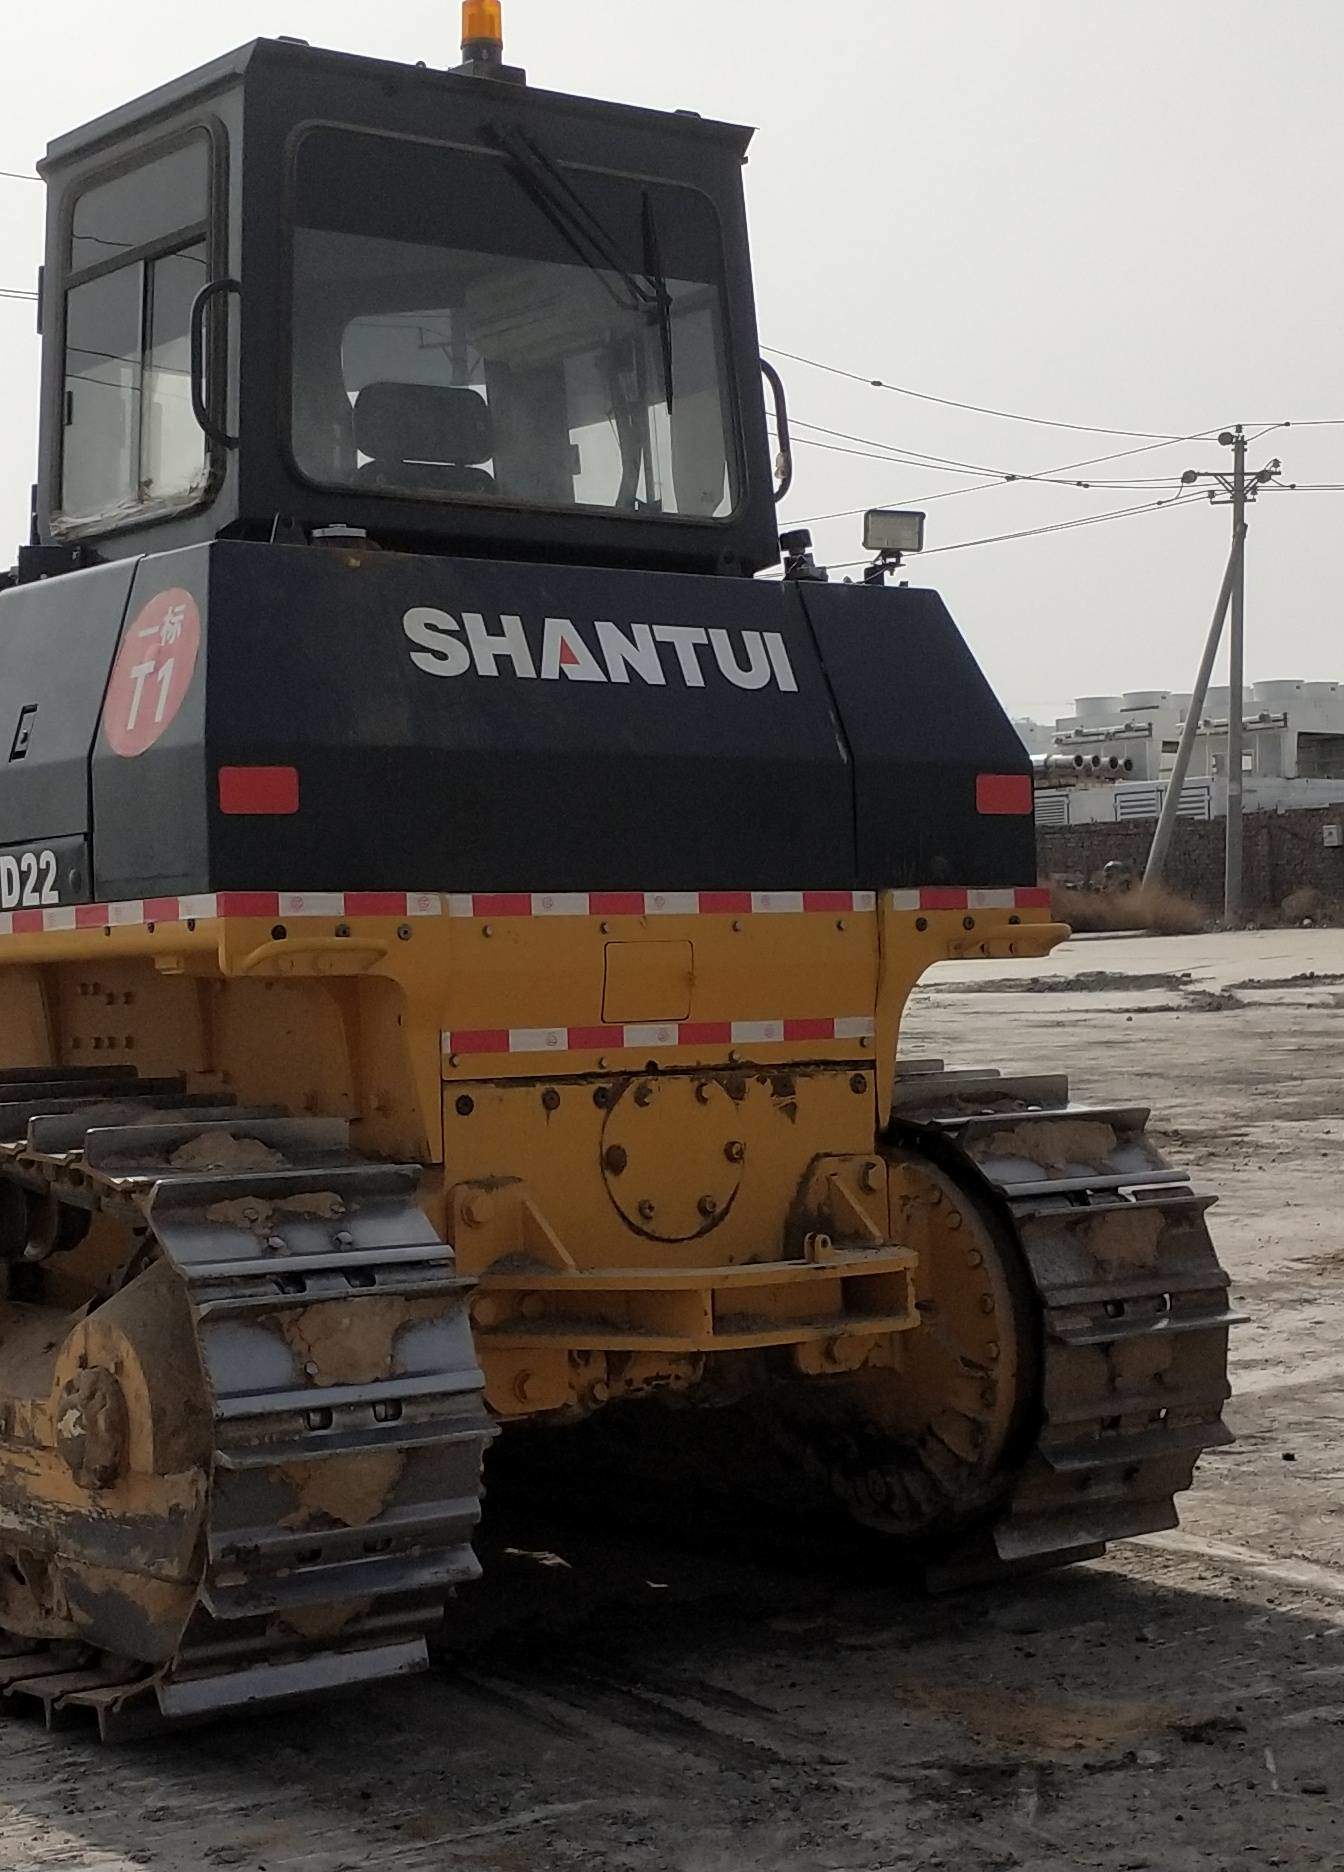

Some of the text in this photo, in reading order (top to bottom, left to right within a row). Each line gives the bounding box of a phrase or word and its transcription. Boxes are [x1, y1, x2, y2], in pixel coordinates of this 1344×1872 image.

[137, 604, 187, 647] 一标
[402, 606, 799, 692] SHANTUI
[127, 657, 175, 731] T1
